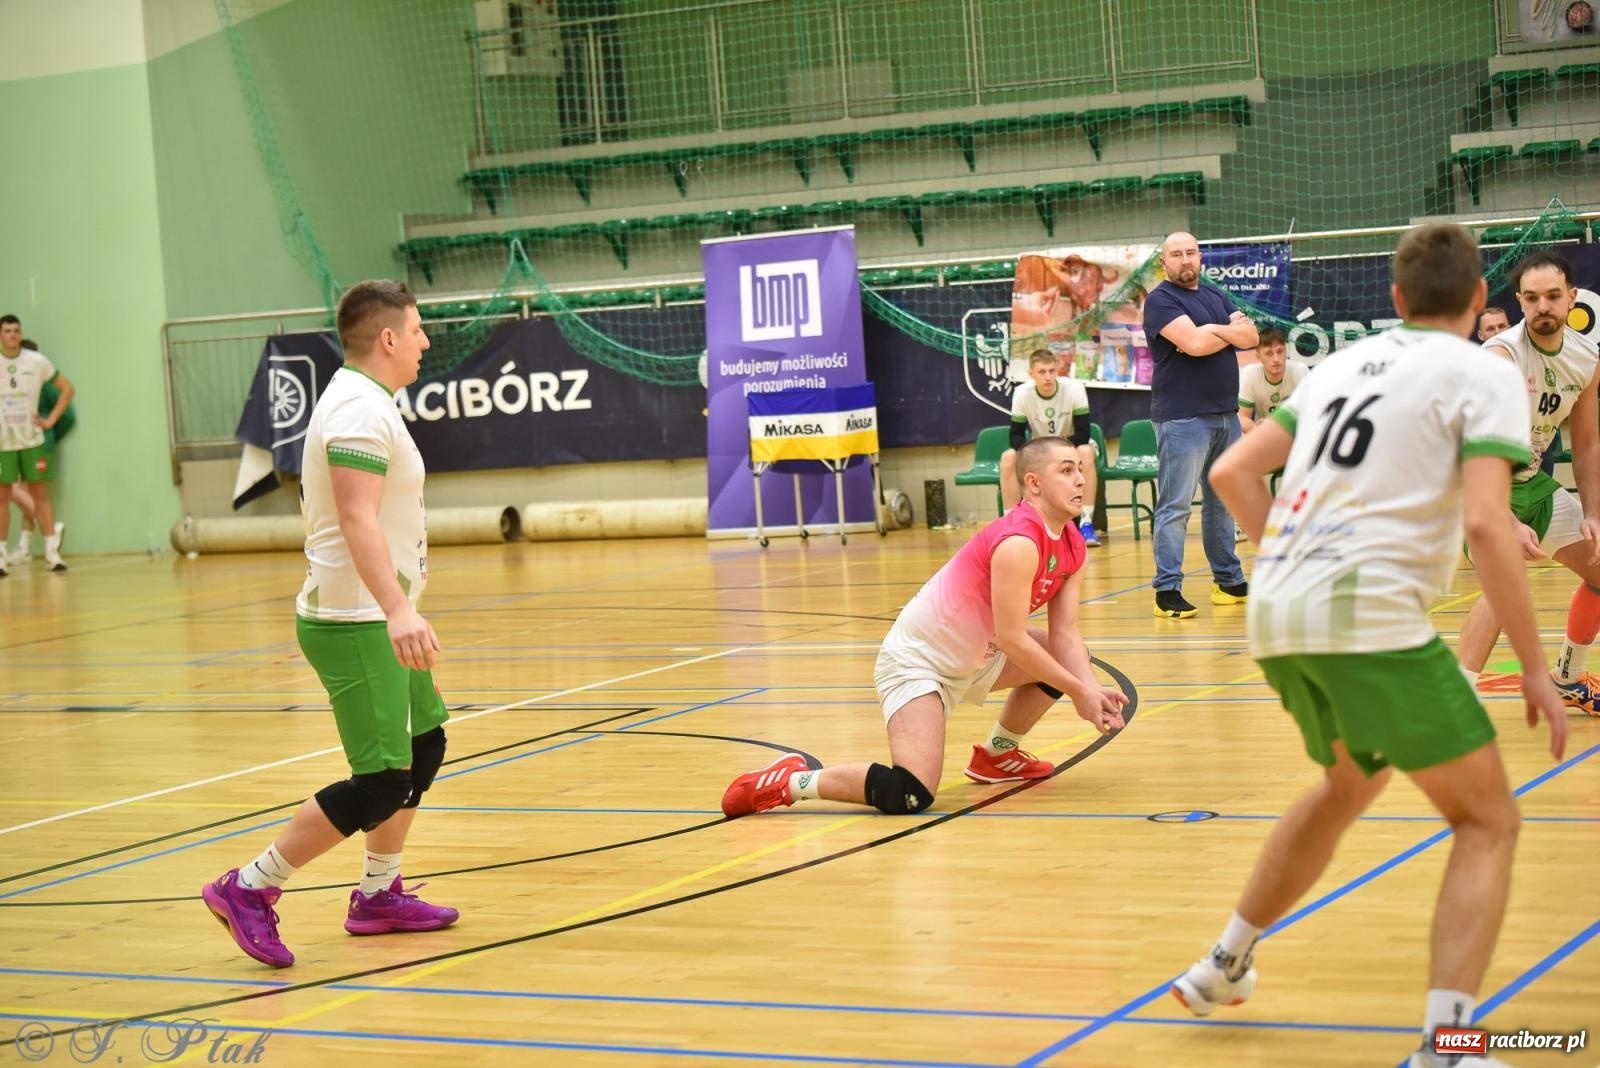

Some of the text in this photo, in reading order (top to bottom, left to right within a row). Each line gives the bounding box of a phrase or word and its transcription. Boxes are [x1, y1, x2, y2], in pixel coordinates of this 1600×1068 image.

[1200, 262, 1278, 281] lexadin
[746, 260, 816, 339] bmp
[720, 353, 848, 377] budujemy możliwości
[394, 360, 592, 422] ACIBÓRZ
[743, 375, 827, 397] porozumienia
[1537, 392, 1561, 416] 49
[1048, 420, 1055, 434] 3
[1308, 394, 1384, 471] 16
